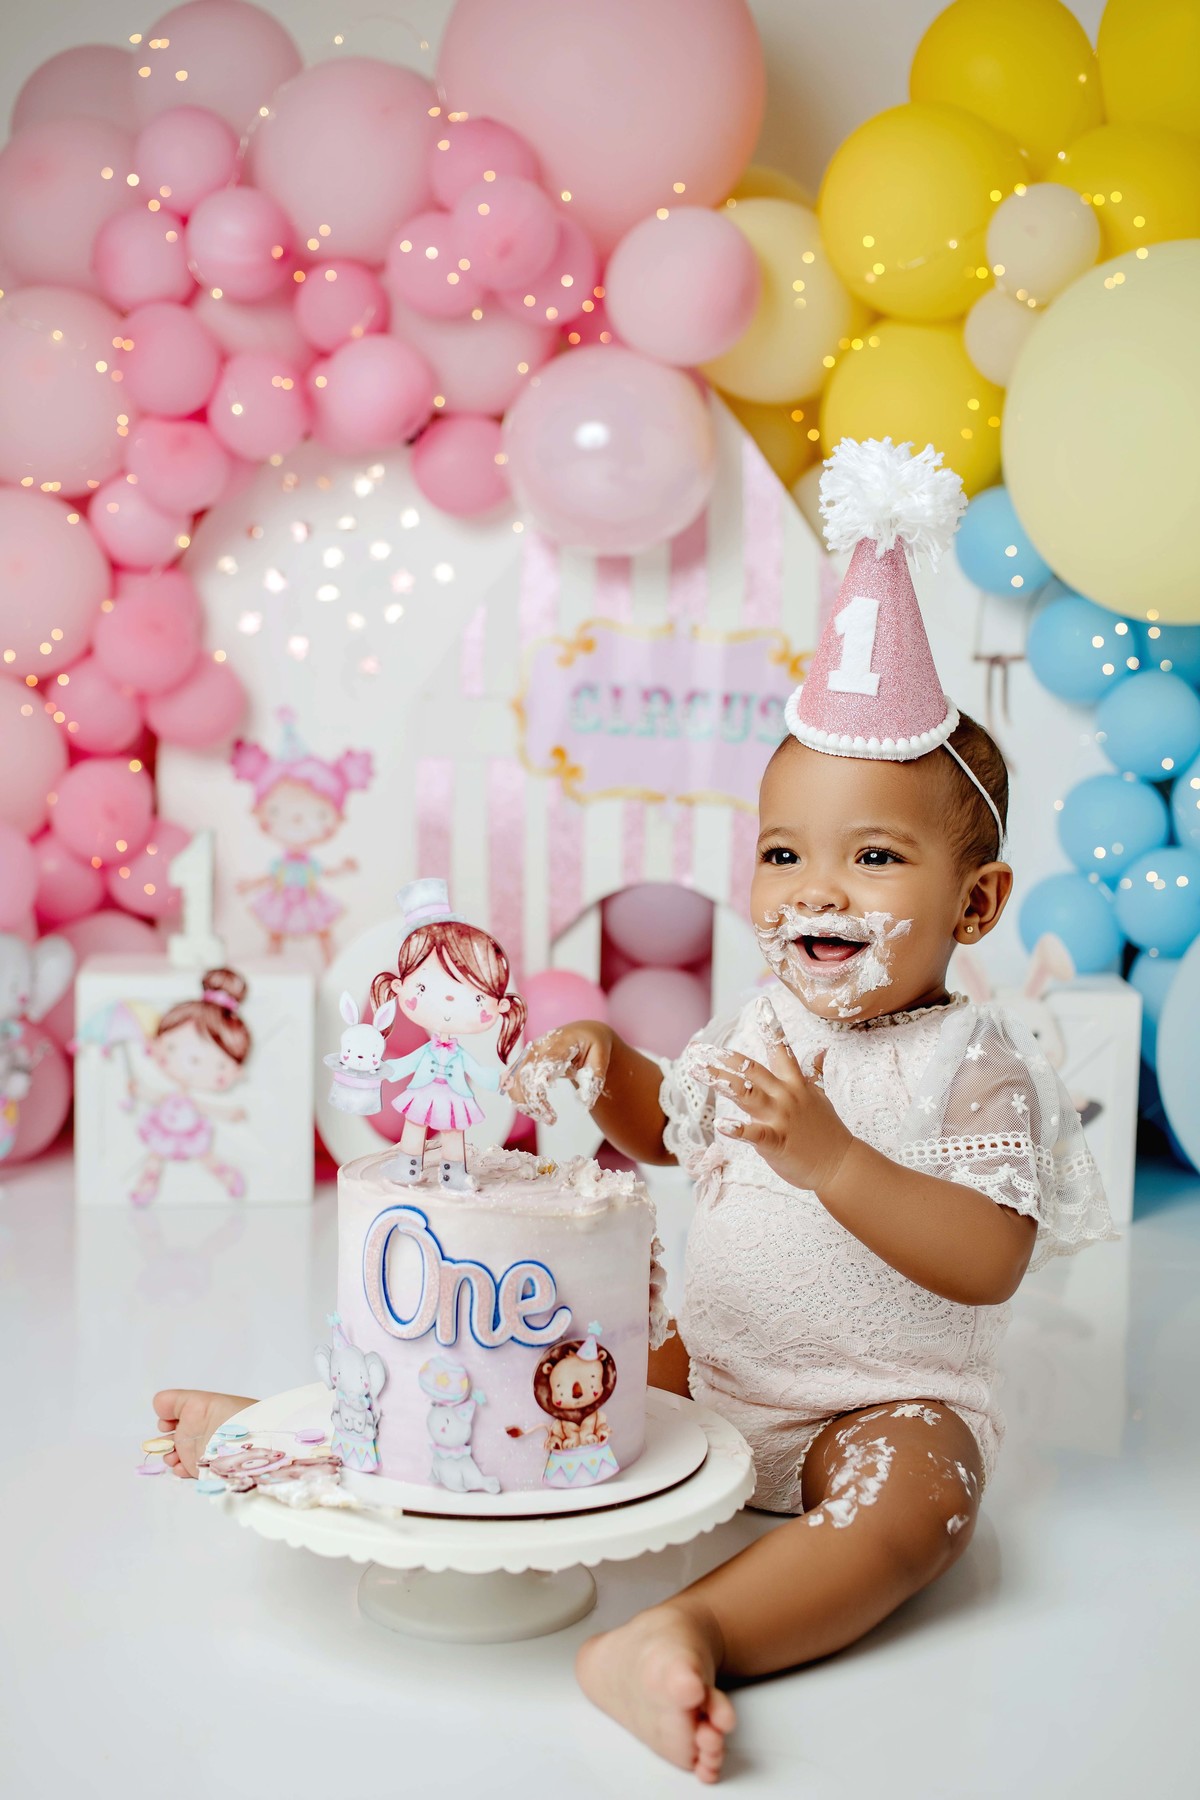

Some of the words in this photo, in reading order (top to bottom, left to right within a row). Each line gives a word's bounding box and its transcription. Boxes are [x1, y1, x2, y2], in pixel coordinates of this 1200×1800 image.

[827, 596, 881, 697] 1
[570, 682, 788, 746] CIRCUS
[168, 831, 224, 967] 1
[362, 1205, 573, 1349] One
